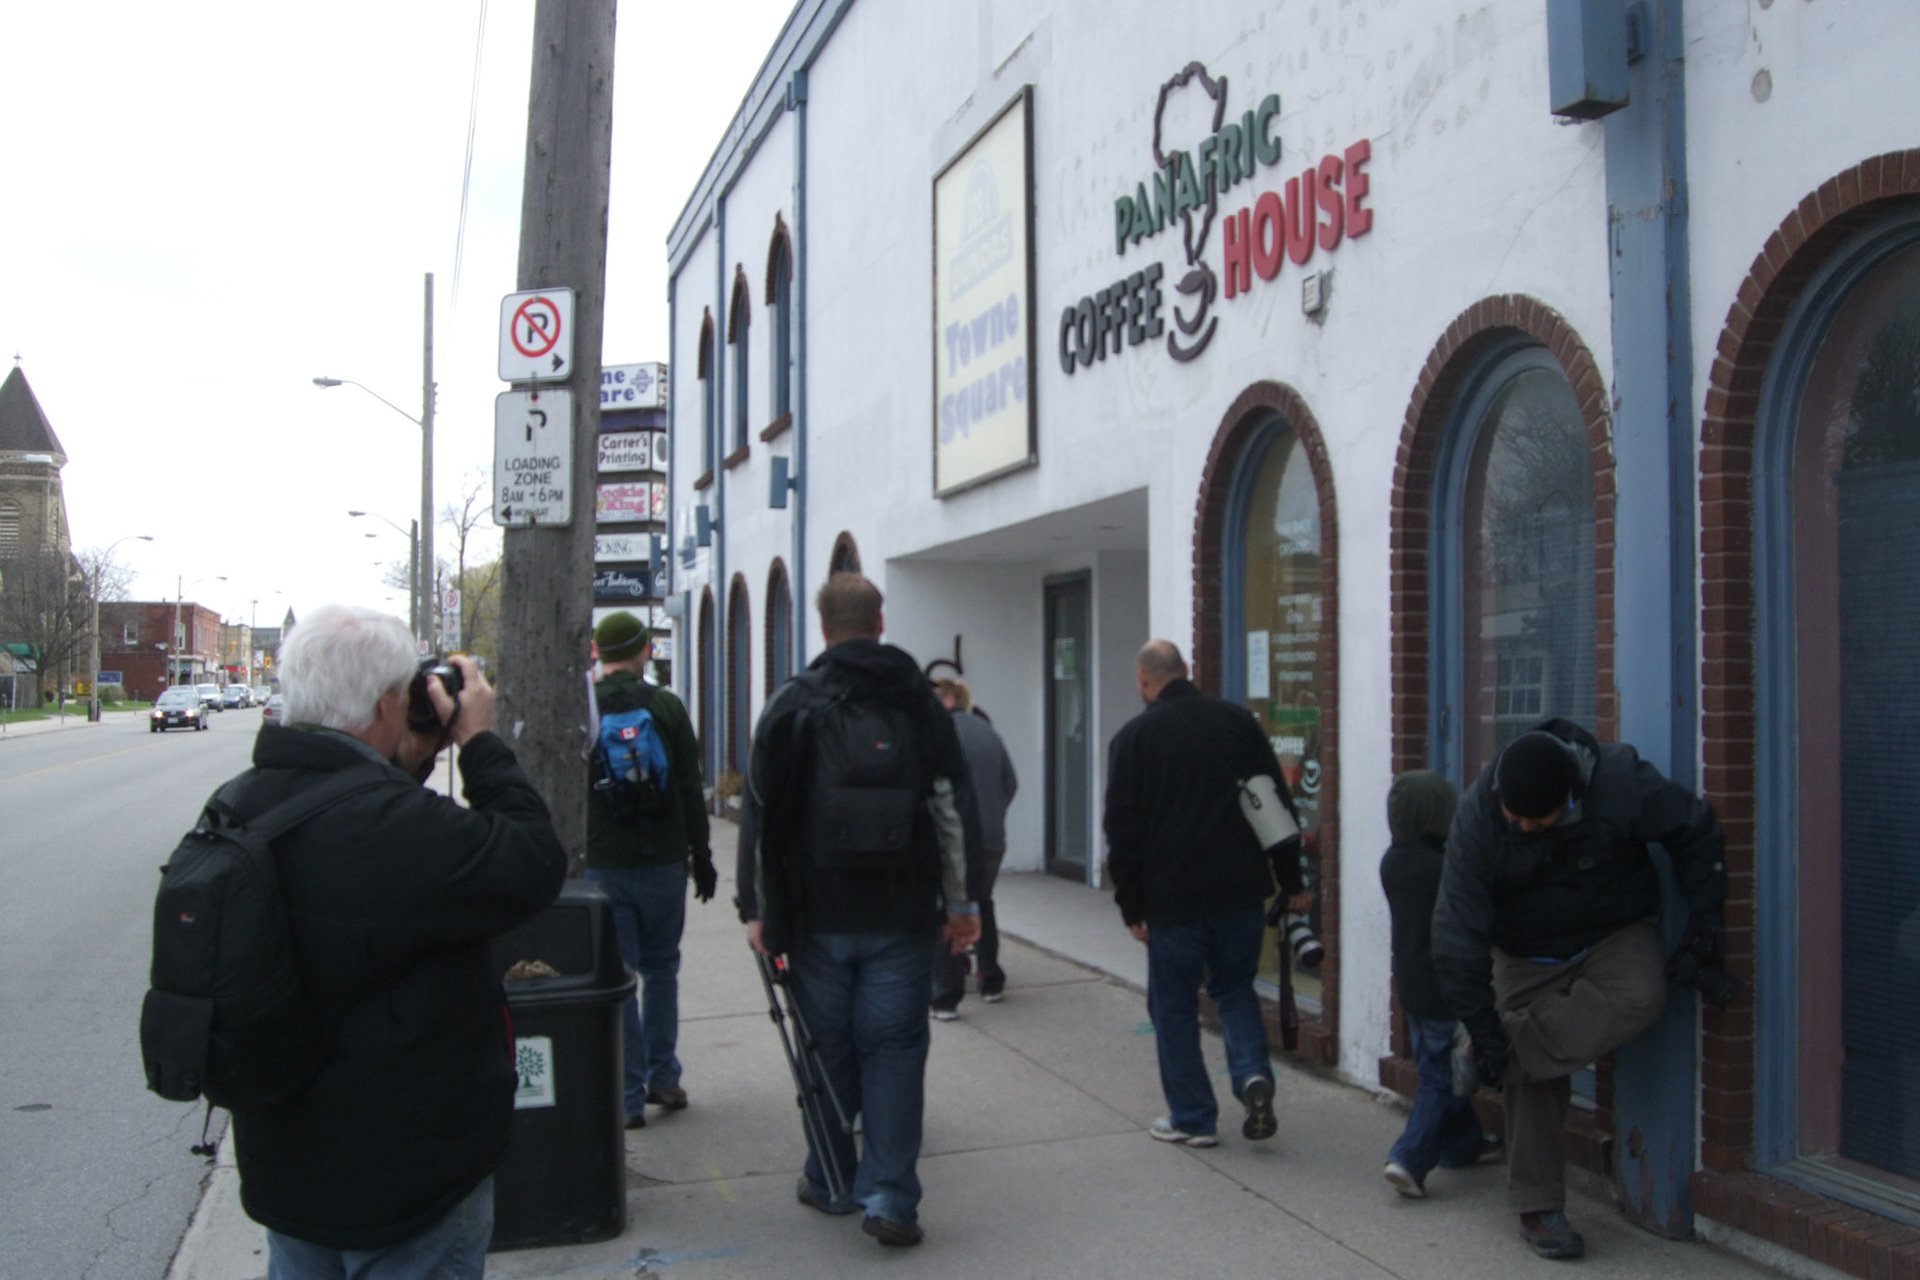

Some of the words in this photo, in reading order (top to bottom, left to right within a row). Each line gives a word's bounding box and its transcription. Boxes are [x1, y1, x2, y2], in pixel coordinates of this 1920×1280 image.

[1115, 93, 1281, 255] PANAFRIC
[1059, 262, 1164, 374] COFFEE
[1223, 139, 1373, 299] HOUSE
[945, 291, 1019, 378] Towne
[601, 370, 625, 385] ne
[600, 388, 635, 402] are
[601, 434, 648, 450] Carter's
[504, 456, 560, 471] LOADING
[599, 451, 646, 465] Printing
[513, 471, 552, 486] ZONE
[605, 500, 646, 514] King
